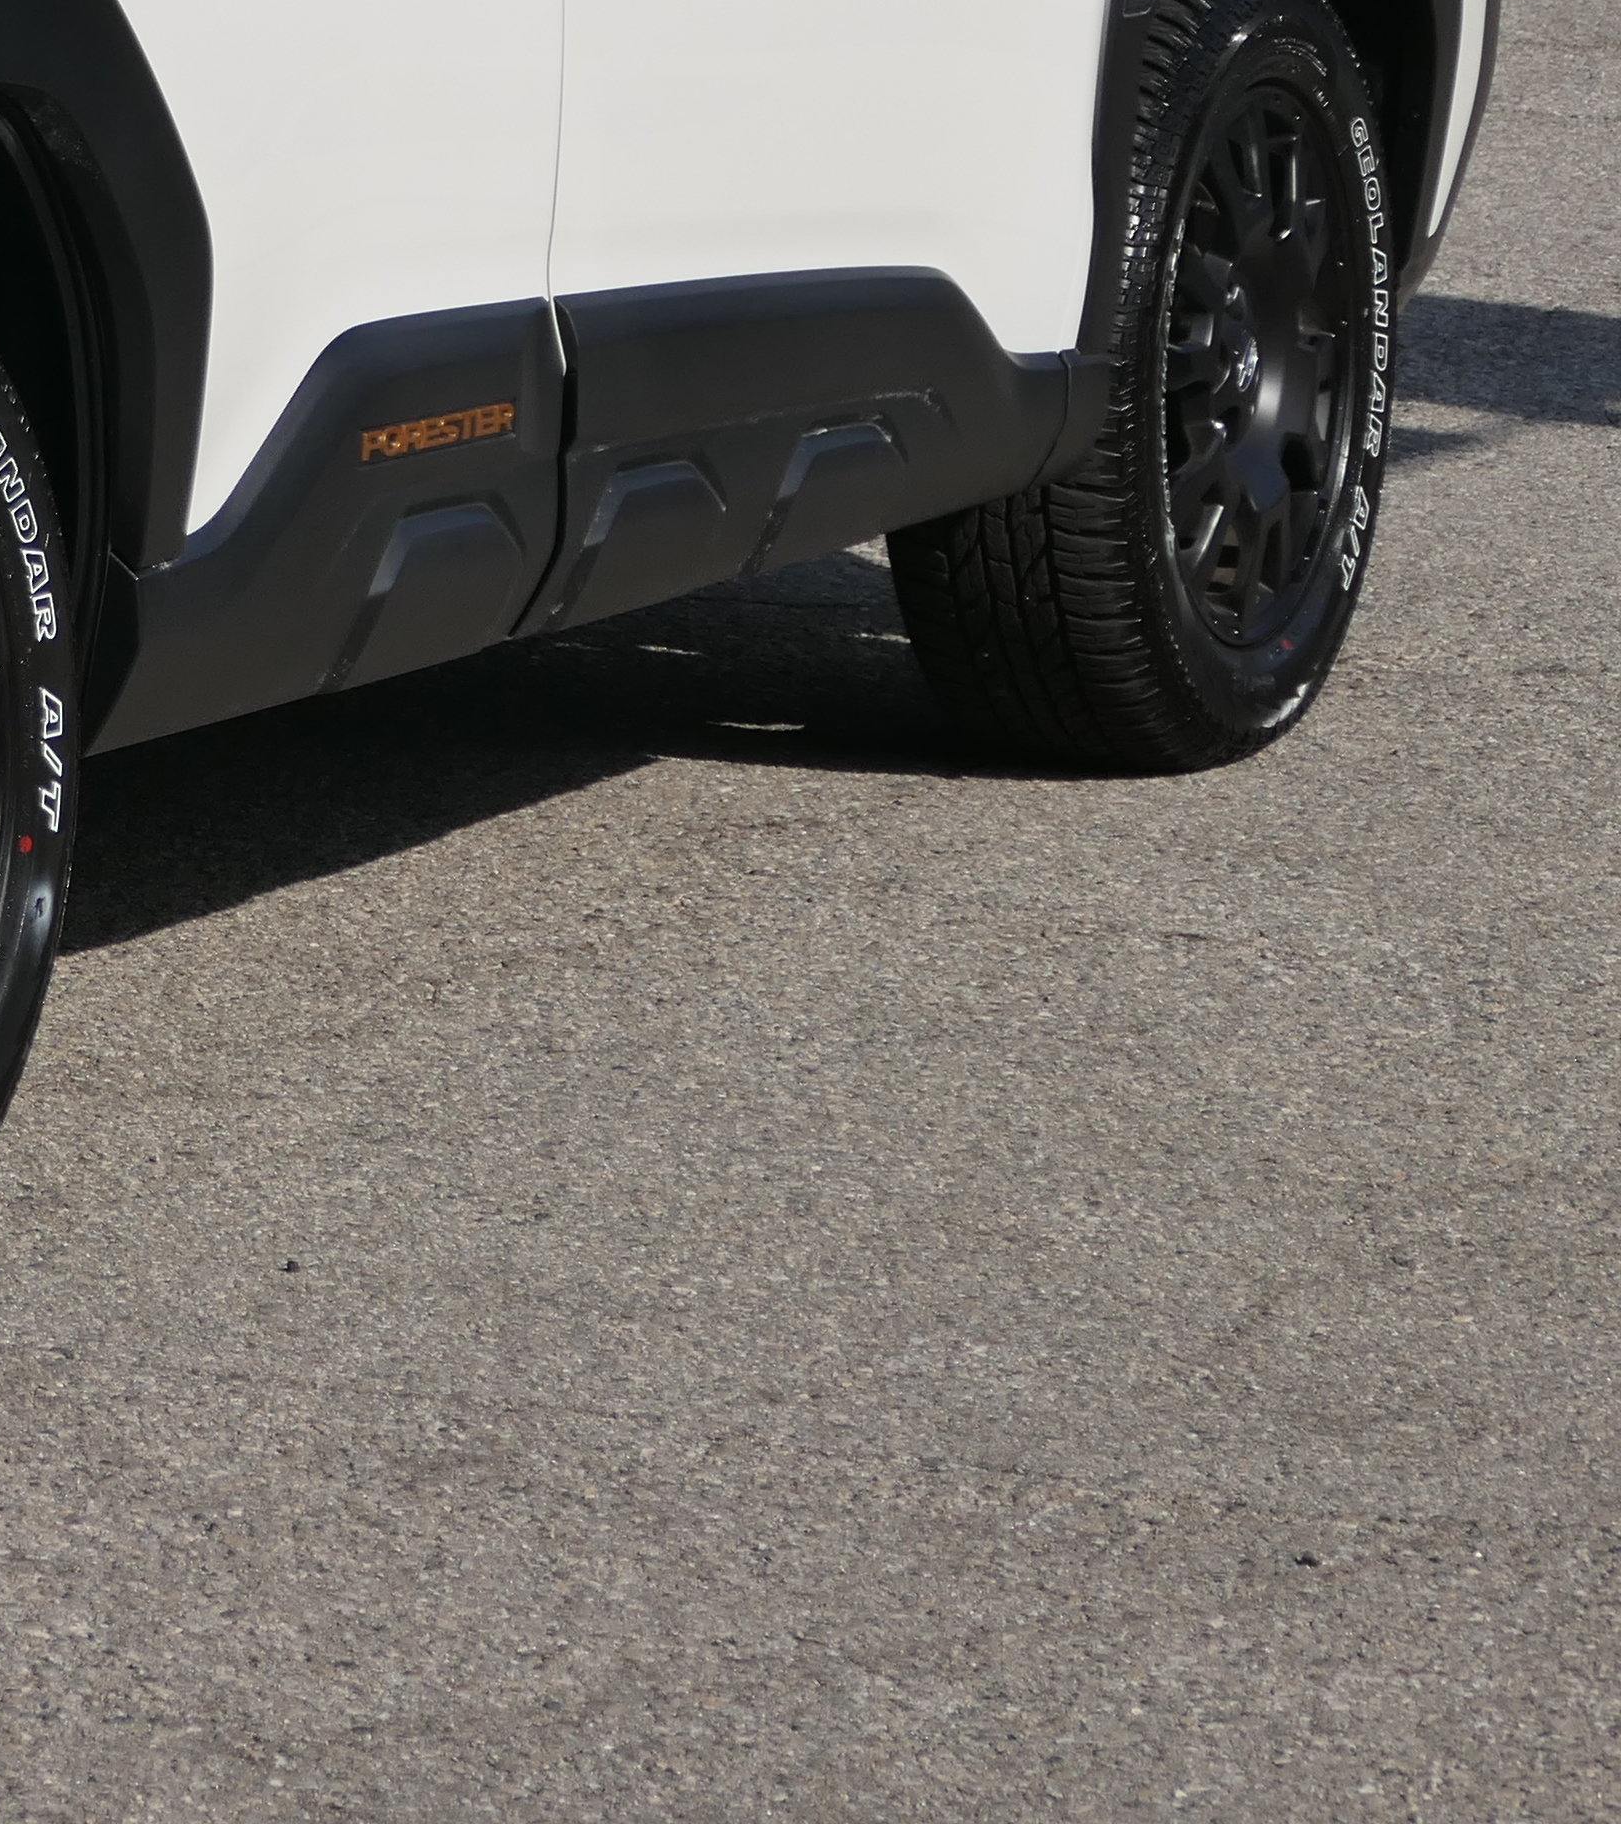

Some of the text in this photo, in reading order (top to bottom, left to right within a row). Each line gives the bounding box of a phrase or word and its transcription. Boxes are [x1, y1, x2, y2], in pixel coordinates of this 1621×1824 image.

[1339, 115, 1390, 594] GEOLANDAR A/T
[359, 402, 517, 463] FORESTER
[36, 684, 65, 833] A/T
